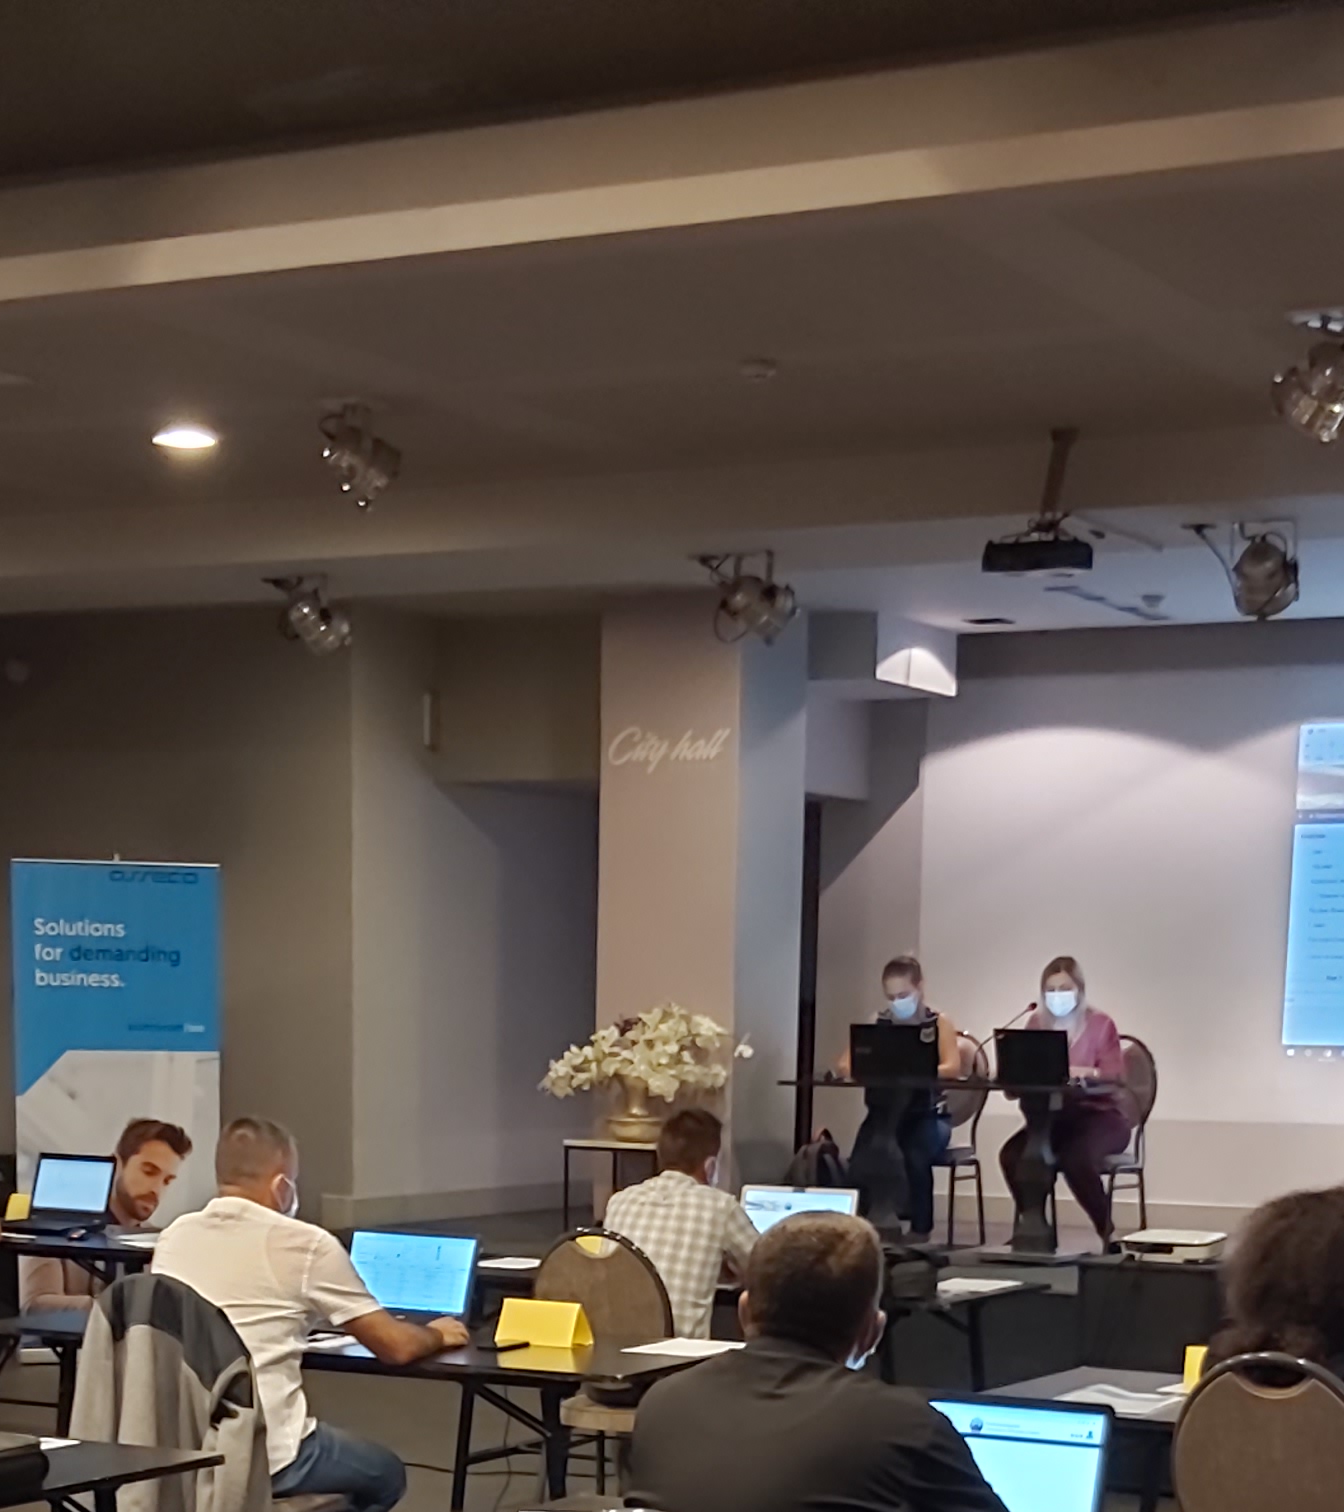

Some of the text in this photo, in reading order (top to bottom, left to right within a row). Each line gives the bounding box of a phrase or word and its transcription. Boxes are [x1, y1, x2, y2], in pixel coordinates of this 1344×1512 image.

[608, 726, 731, 774] City hall
[33, 917, 126, 937] Solutions
[33, 943, 181, 967] for demanding
[34, 968, 126, 987] business.
